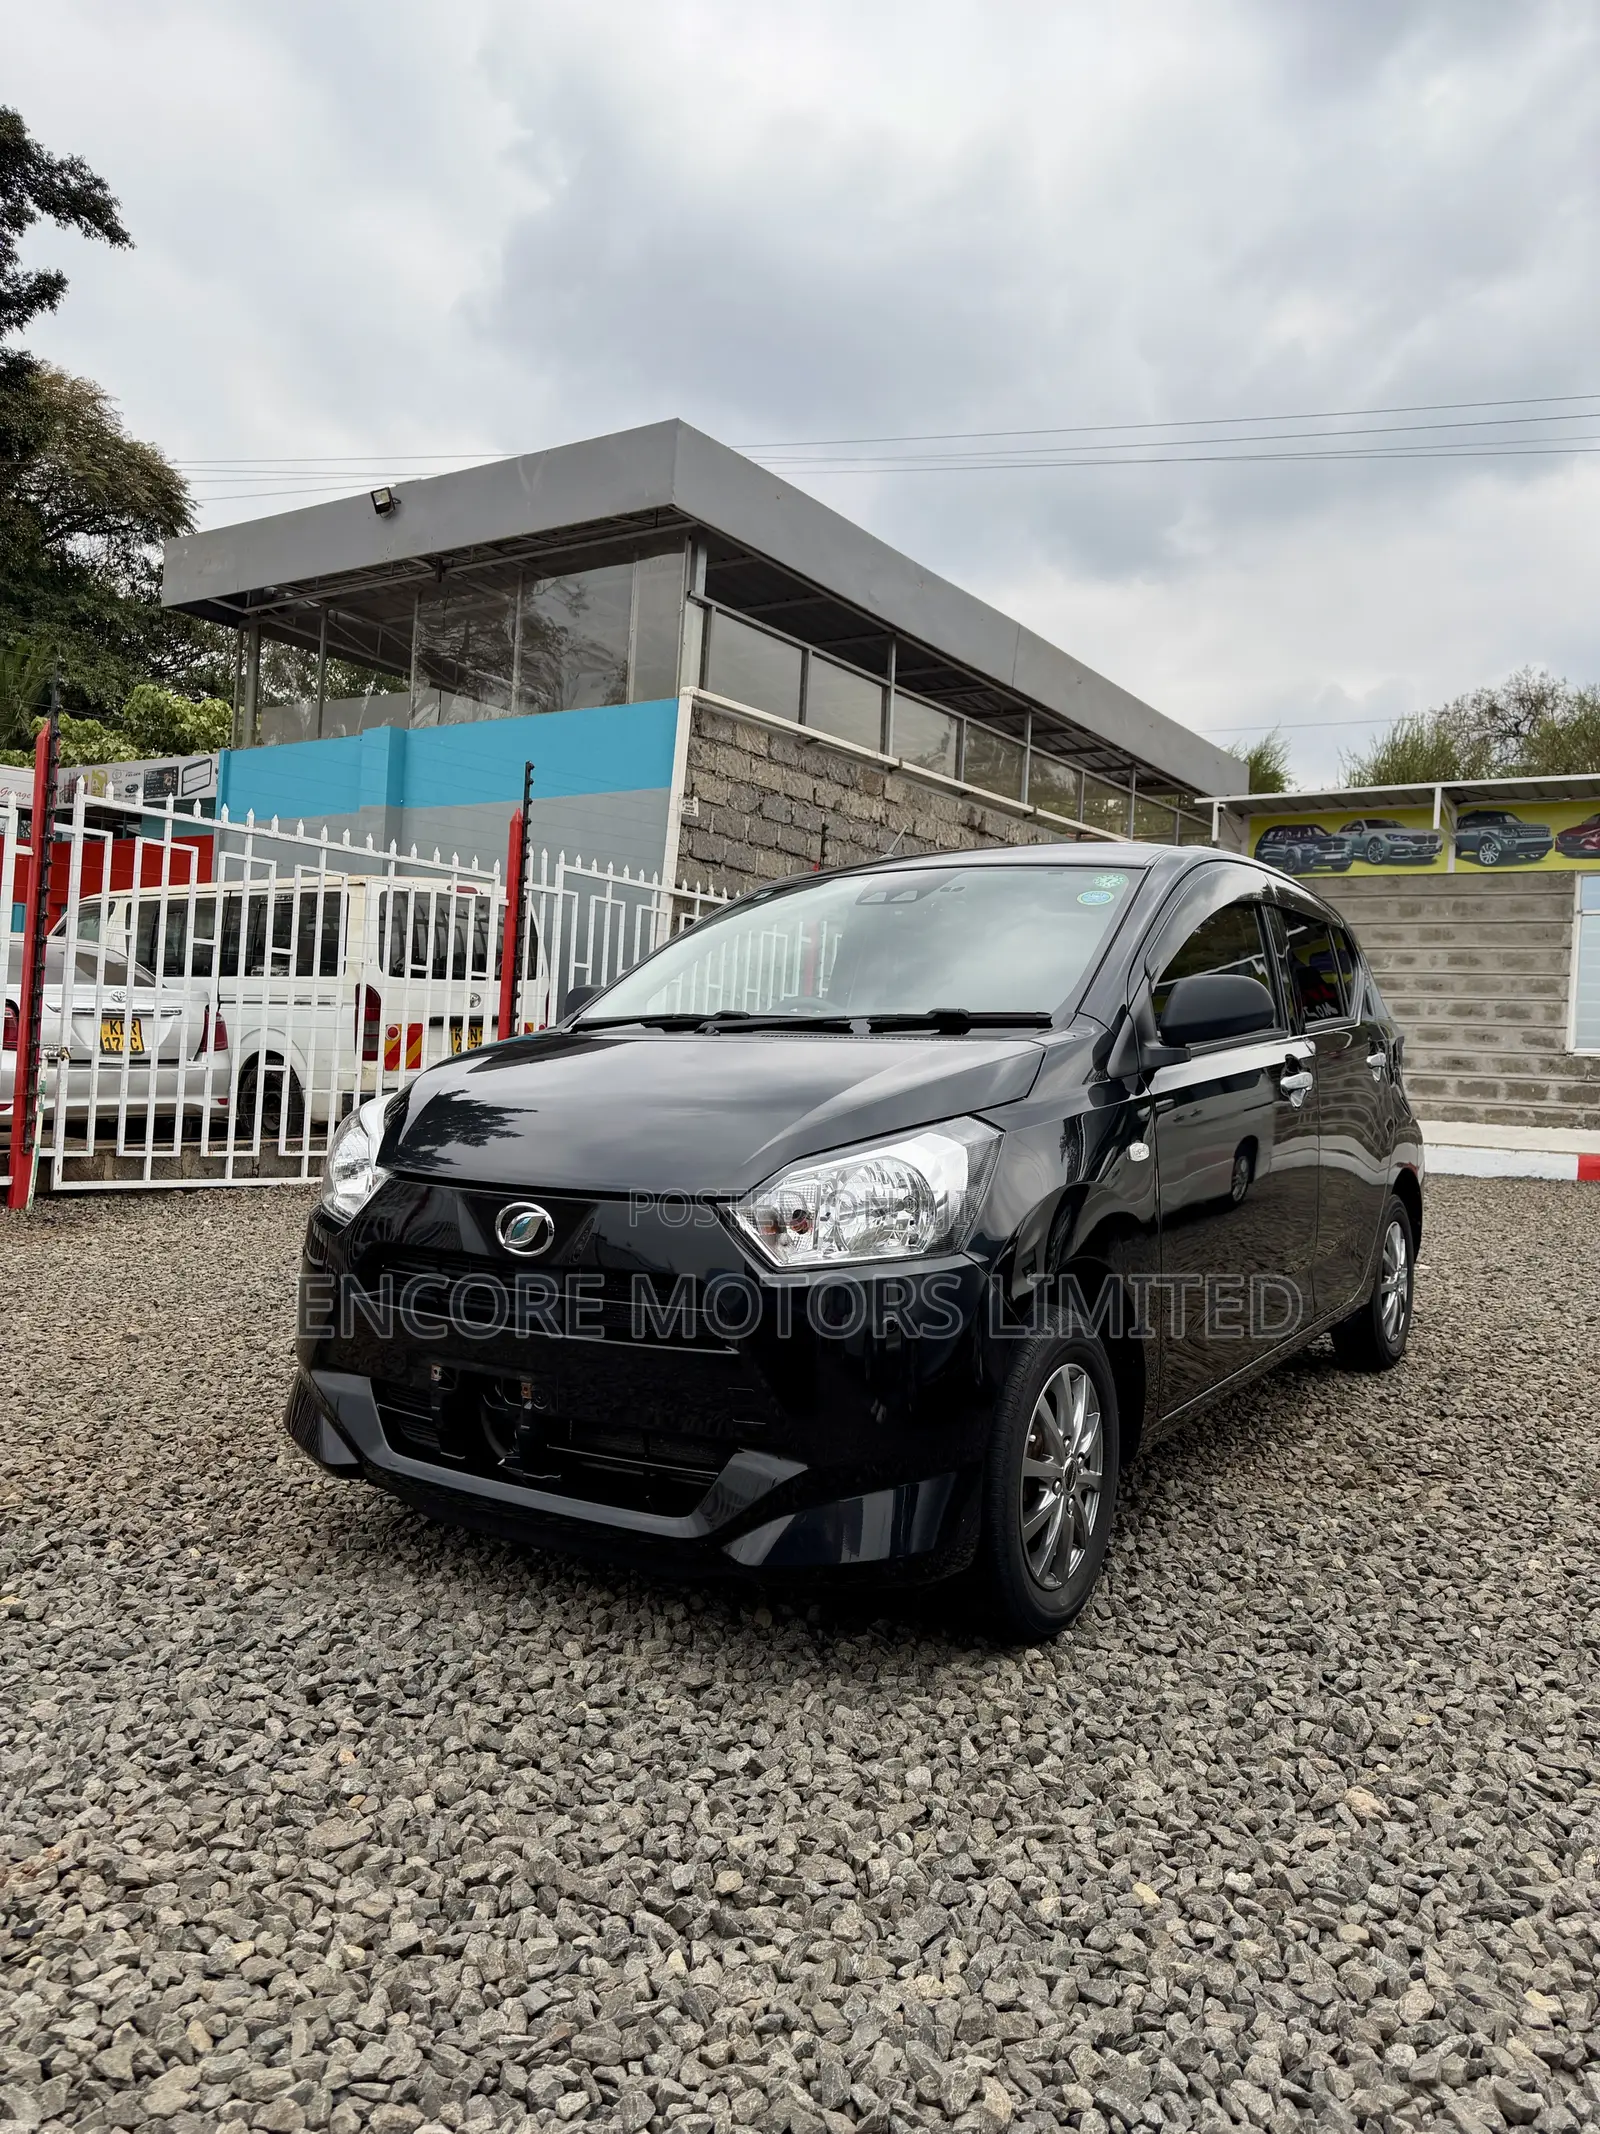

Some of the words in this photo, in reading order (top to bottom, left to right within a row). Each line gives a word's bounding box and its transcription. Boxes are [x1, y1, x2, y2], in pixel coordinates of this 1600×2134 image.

[0, 786, 32, 800] Gaage
[455, 1028, 478, 1041] KN
[104, 1037, 140, 1051] 17C
